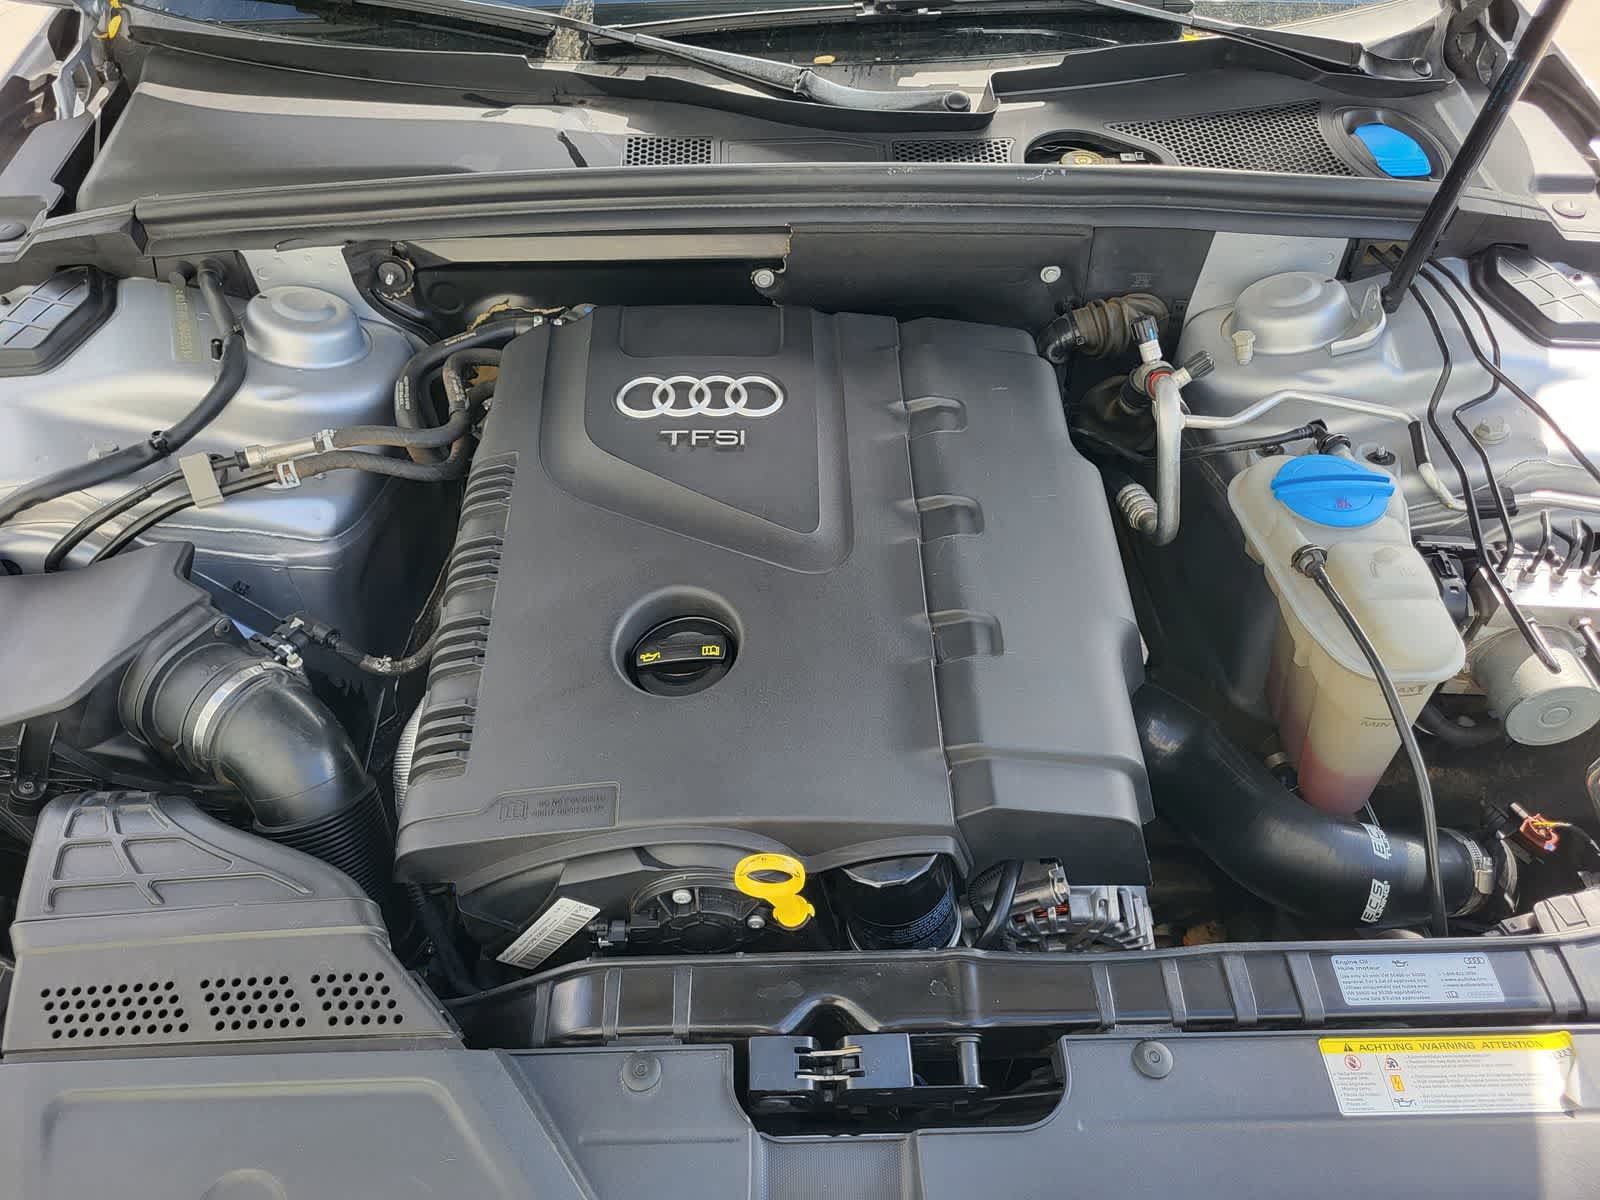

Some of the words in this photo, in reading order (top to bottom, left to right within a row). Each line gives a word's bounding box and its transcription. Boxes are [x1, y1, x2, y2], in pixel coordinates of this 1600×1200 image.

[660, 430, 745, 446] TFSI
[1360, 879, 1384, 922] ECS
[1359, 1043, 1413, 1052] ACHTUNG
[1418, 1041, 1476, 1050] WARNING
[1482, 1040, 1545, 1049] ATTENTION
